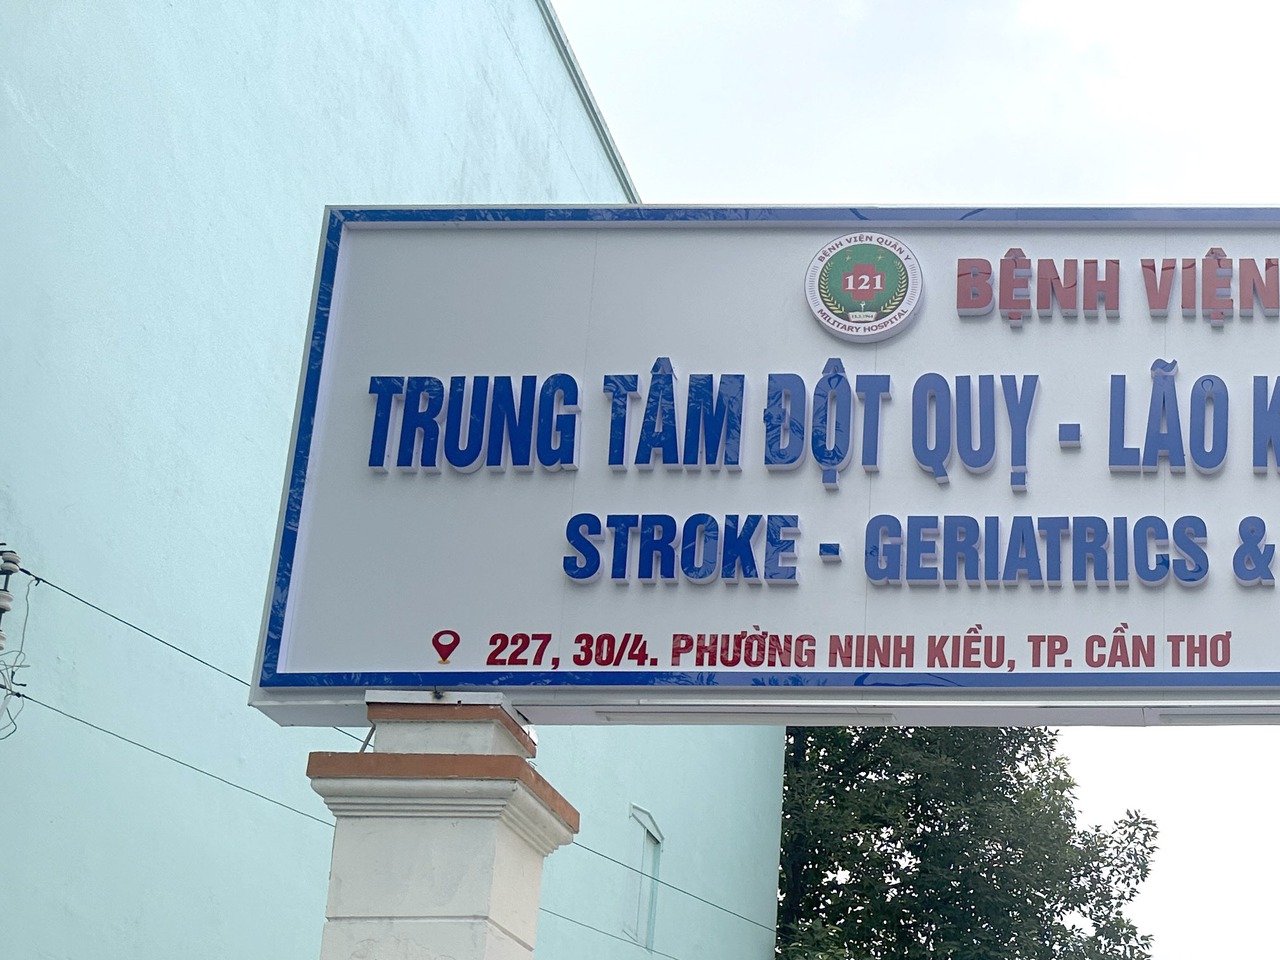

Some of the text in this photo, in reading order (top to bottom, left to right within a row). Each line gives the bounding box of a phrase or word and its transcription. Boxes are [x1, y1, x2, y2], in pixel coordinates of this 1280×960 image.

[818, 240, 843, 262] BỆNH
[845, 234, 873, 245] VIỆN
[876, 237, 905, 254] QUÂN
[845, 274, 884, 290] 121
[957, 248, 1120, 328] BỆNH
[1141, 248, 1280, 328] VIỆN
[817, 308, 909, 332] MILITARY HOSPITAL
[368, 373, 582, 474] TRUNG
[603, 356, 745, 472] TÂM
[764, 357, 892, 490] ĐỘT
[911, 372, 1040, 492] QUỴ
[1058, 423, 1083, 448] -
[1109, 356, 1231, 476] LÃO
[562, 512, 800, 585] STROKE
[819, 543, 842, 563] -
[864, 514, 1211, 587] GERIATRICS
[1231, 515, 1277, 587] &
[486, 622, 1232, 672] 227, 30/4. PHƯỜNG NINH KIỀU, TP. CẦN THƠ
